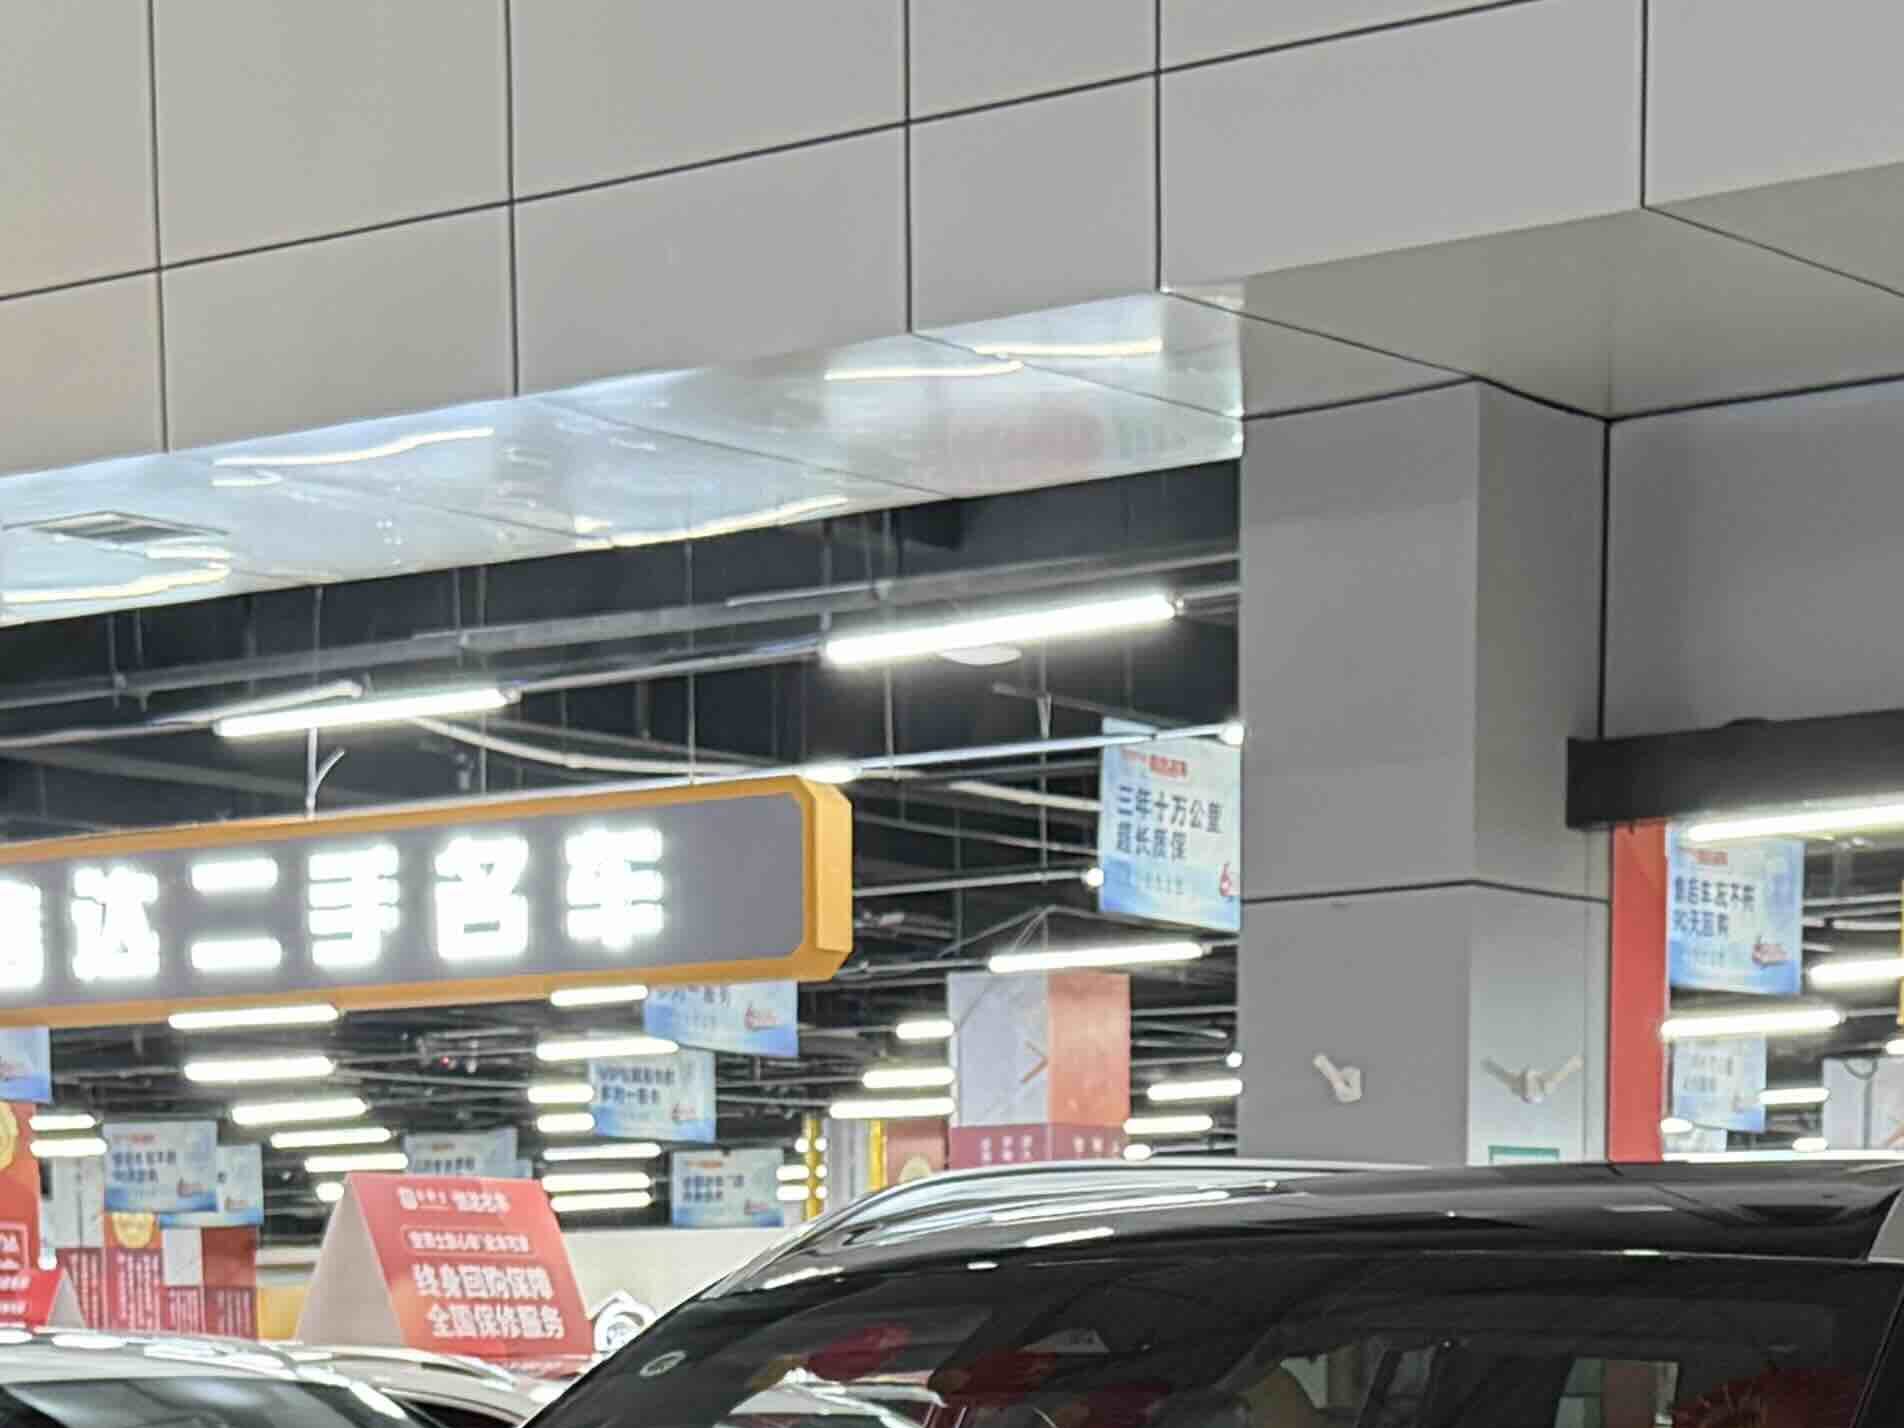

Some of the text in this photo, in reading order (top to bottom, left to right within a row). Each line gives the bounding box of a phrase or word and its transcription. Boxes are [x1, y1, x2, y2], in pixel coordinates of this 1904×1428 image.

[1117, 785, 1223, 835] 三年十万公里
